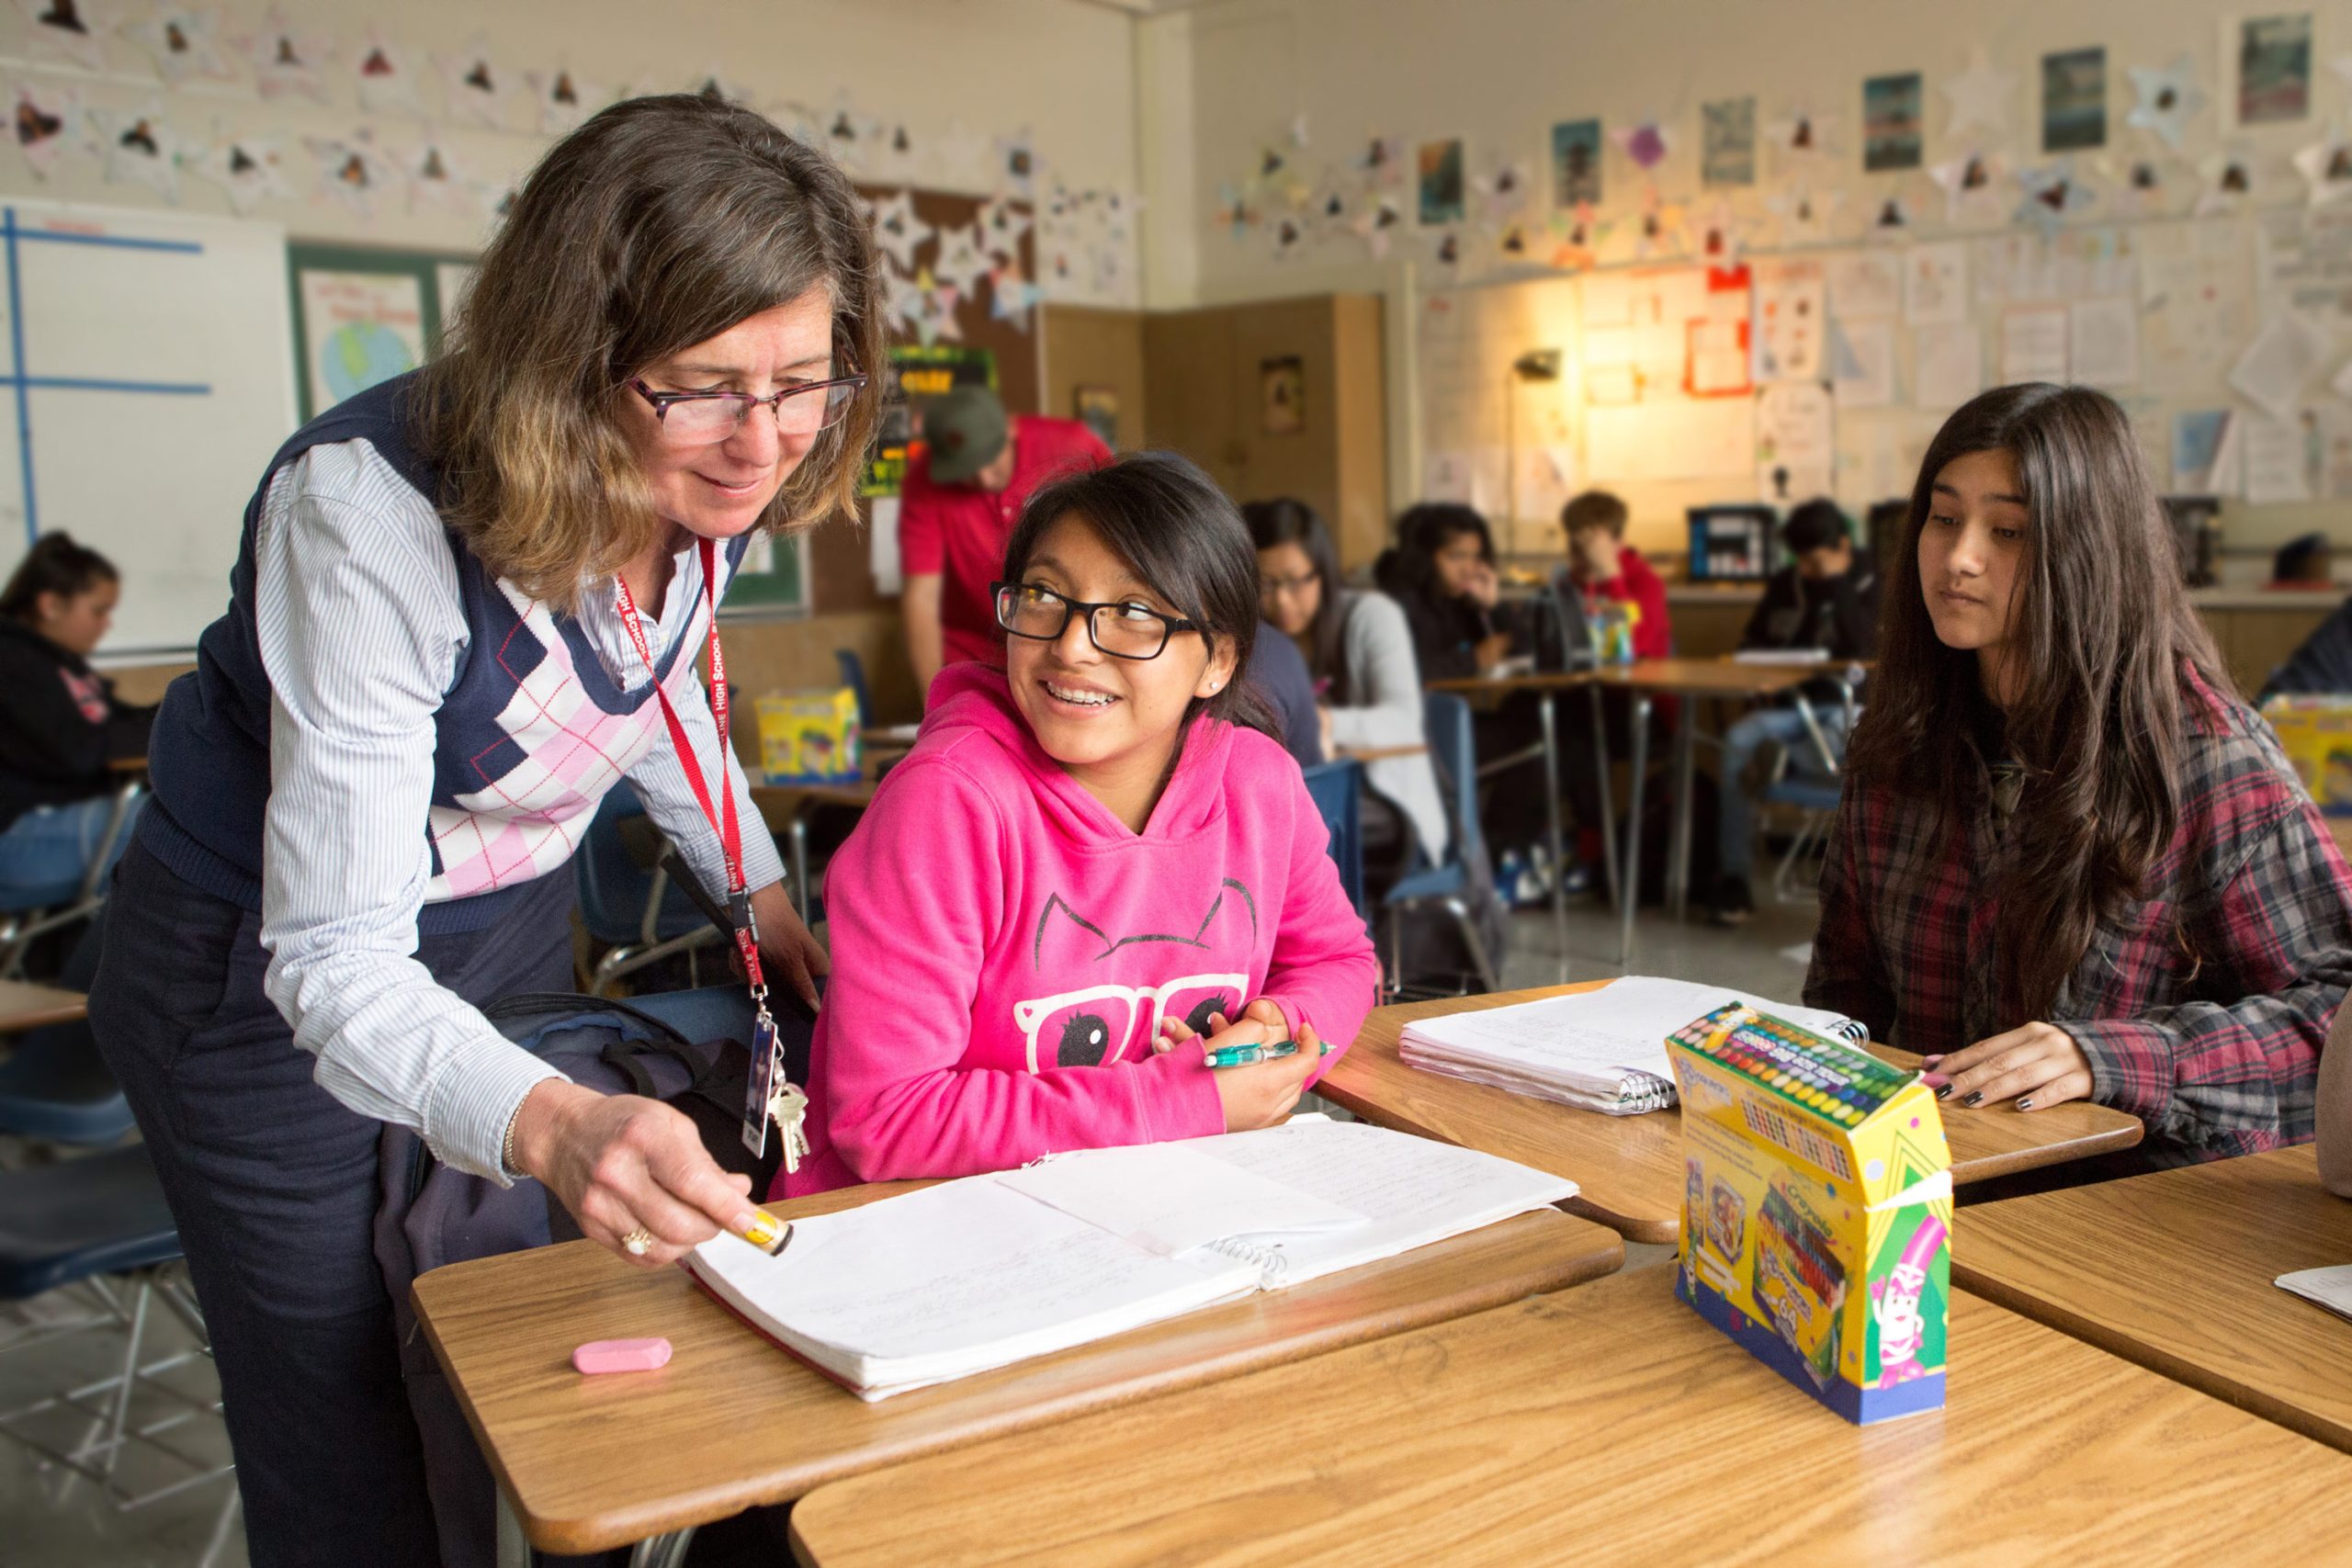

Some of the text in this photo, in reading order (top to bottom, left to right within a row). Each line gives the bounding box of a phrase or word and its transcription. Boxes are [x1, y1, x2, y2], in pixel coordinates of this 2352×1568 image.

[626, 612, 648, 658] SCHOOL
[712, 637, 725, 681] SCHOOL
[715, 682, 727, 711] HIGH
